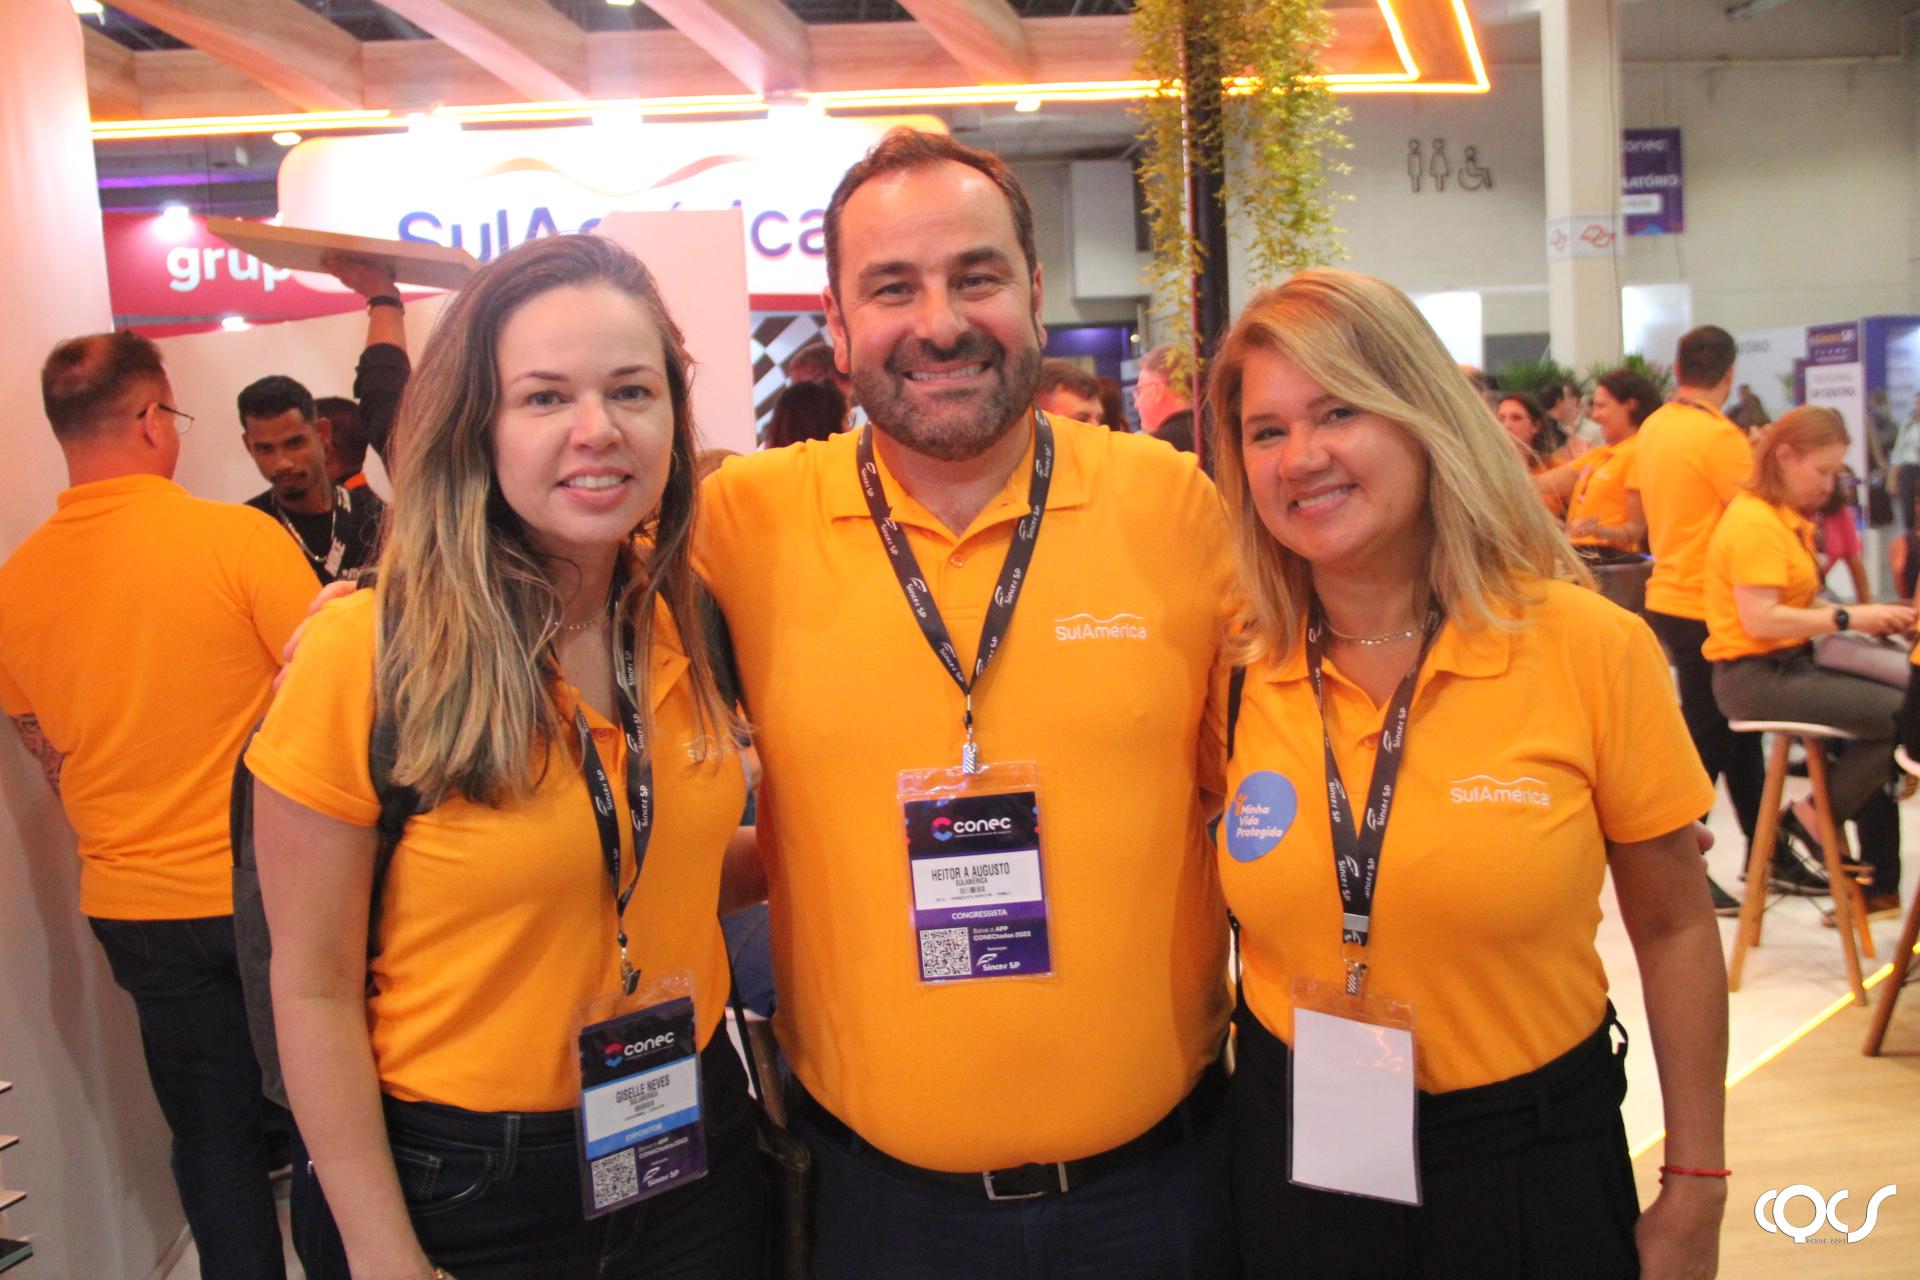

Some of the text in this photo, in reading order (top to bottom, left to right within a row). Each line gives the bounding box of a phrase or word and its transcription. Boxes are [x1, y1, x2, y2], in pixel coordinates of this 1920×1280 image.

[1622, 140, 1664, 152] onec
[953, 817, 1012, 833] conec
[931, 862, 1010, 881] HEITOR A AUGUSTO
[951, 909, 1008, 920] CONGRESSISTA
[624, 1032, 674, 1056] conec
[616, 1074, 670, 1103] GISELLE NEVES
